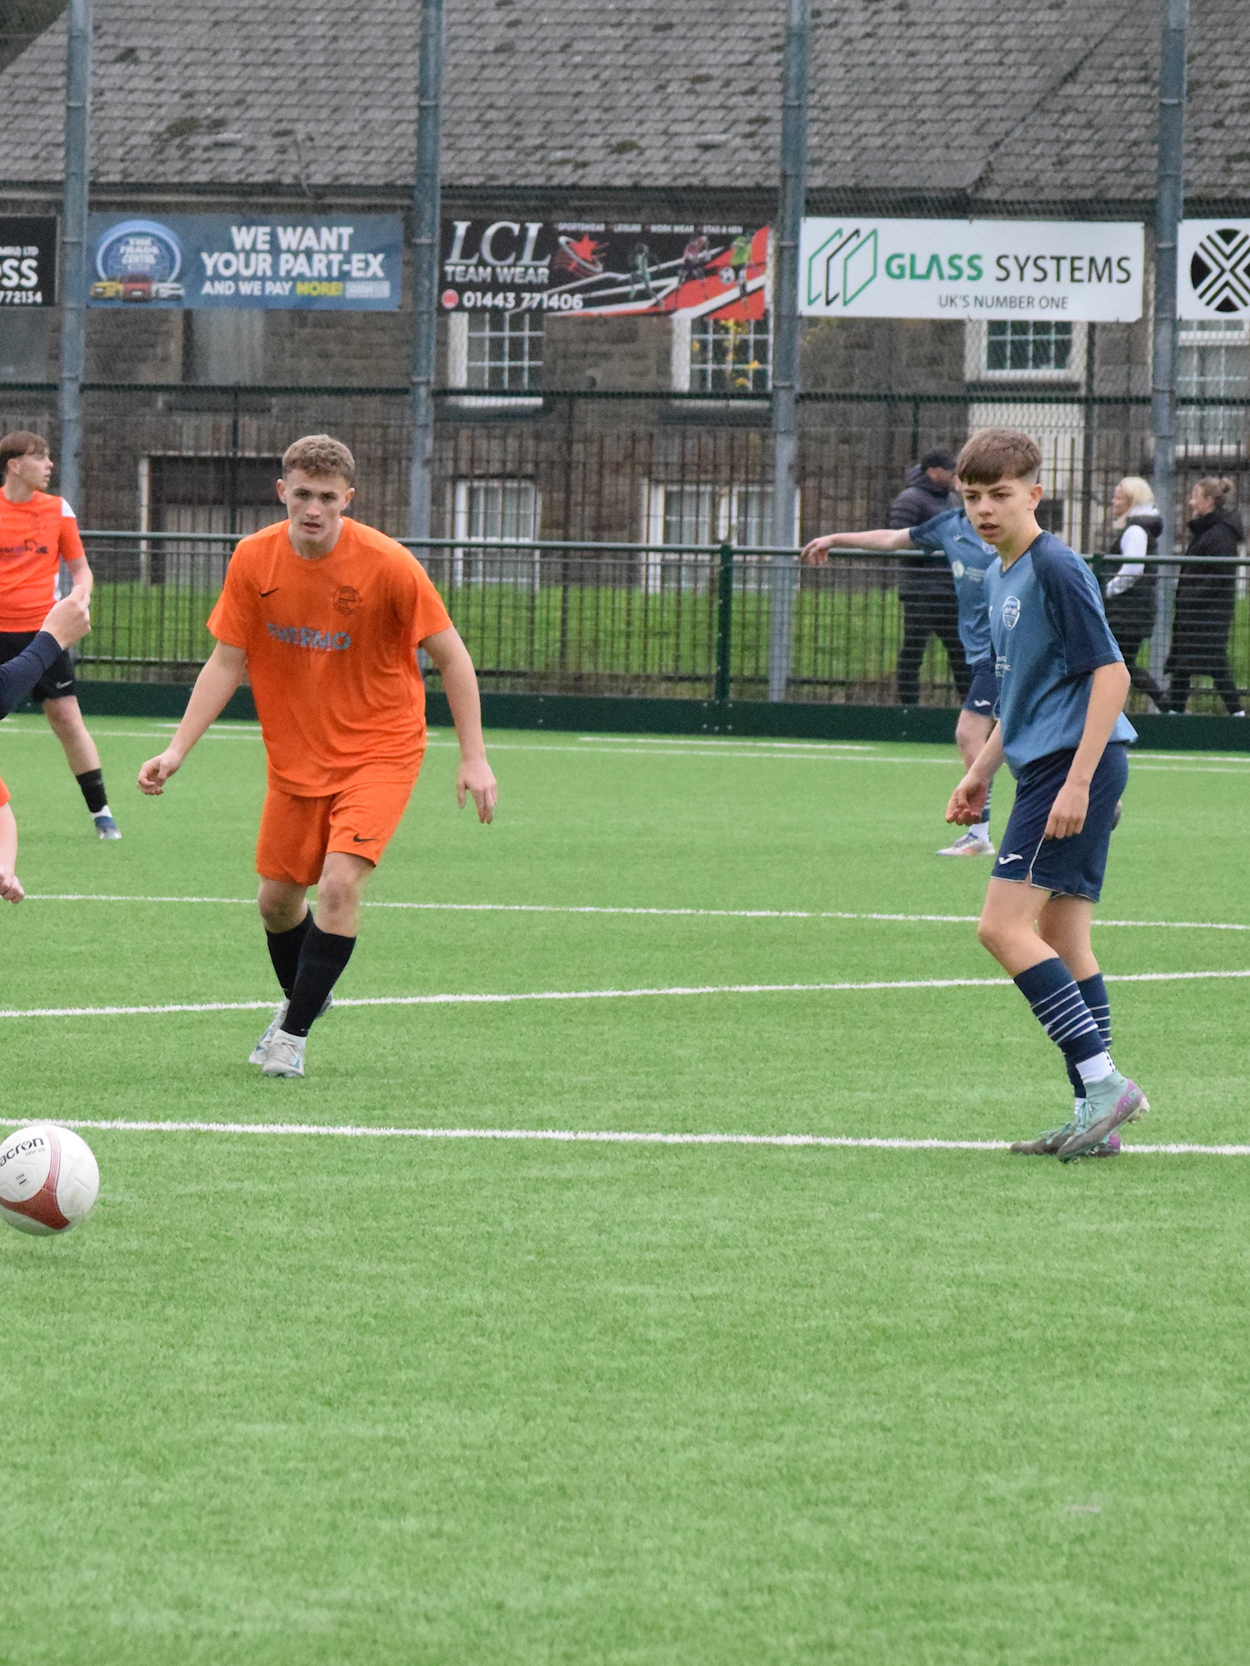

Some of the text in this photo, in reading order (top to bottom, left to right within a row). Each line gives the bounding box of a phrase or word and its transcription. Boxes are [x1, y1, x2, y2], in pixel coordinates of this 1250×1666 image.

[651, 223, 671, 233] WORK
[673, 224, 695, 233] WEAR
[231, 225, 354, 251] WE WANT
[446, 220, 551, 266] LCL
[23, 246, 39, 256] LTD
[201, 252, 385, 278] YOUR PART-EX
[444, 265, 549, 284] TEAM WEAR
[885, 253, 1132, 284] GLASS SYSTEMS
[201, 281, 235, 296] AND
[238, 281, 262, 295] WE
[265, 281, 293, 295] PAY
[463, 291, 584, 310] 01443 771406
[938, 294, 1068, 310] UK'S NUMBER ONE
